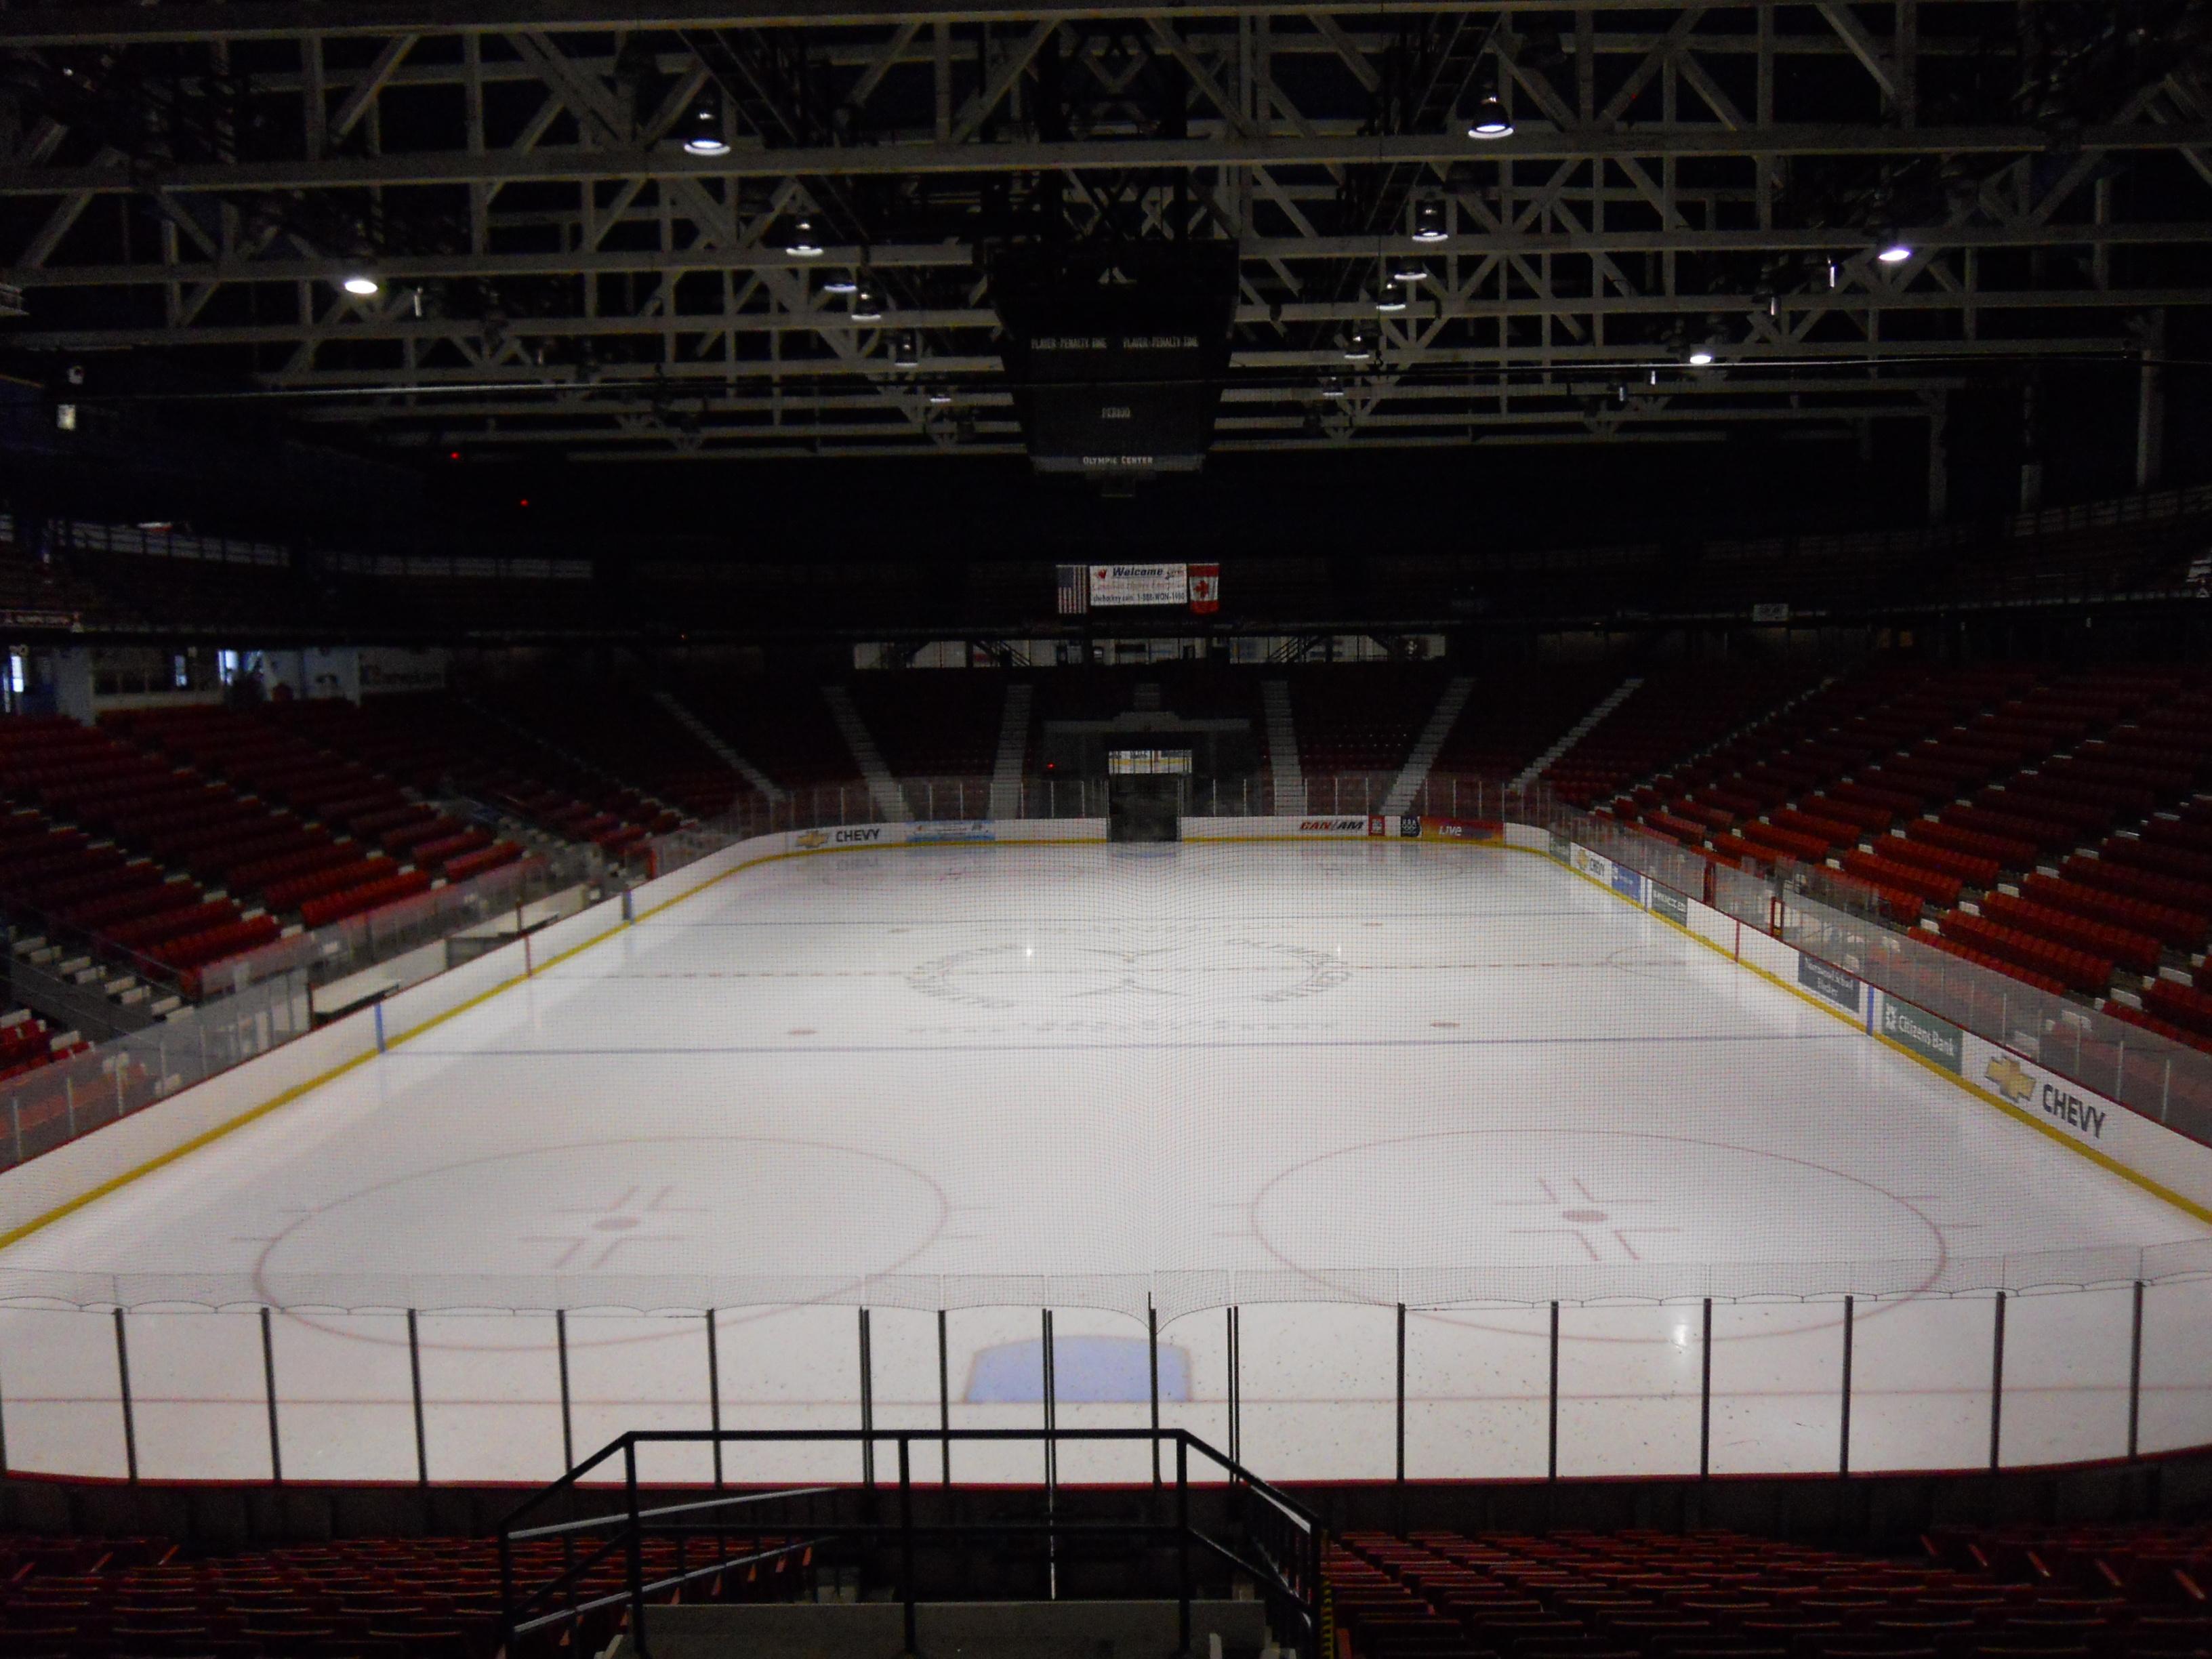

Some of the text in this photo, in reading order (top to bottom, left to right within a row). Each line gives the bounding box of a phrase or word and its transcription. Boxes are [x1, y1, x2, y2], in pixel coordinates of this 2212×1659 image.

[1083, 455, 1153, 464] OLYMPIC CENTER
[1113, 567, 1163, 576] Welcome
[836, 828, 880, 842] CHEVY
[1590, 857, 1605, 877] CHEVY
[1899, 1015, 1954, 1057] Citizens Bank
[2043, 1084, 2106, 1139] CHEVY
